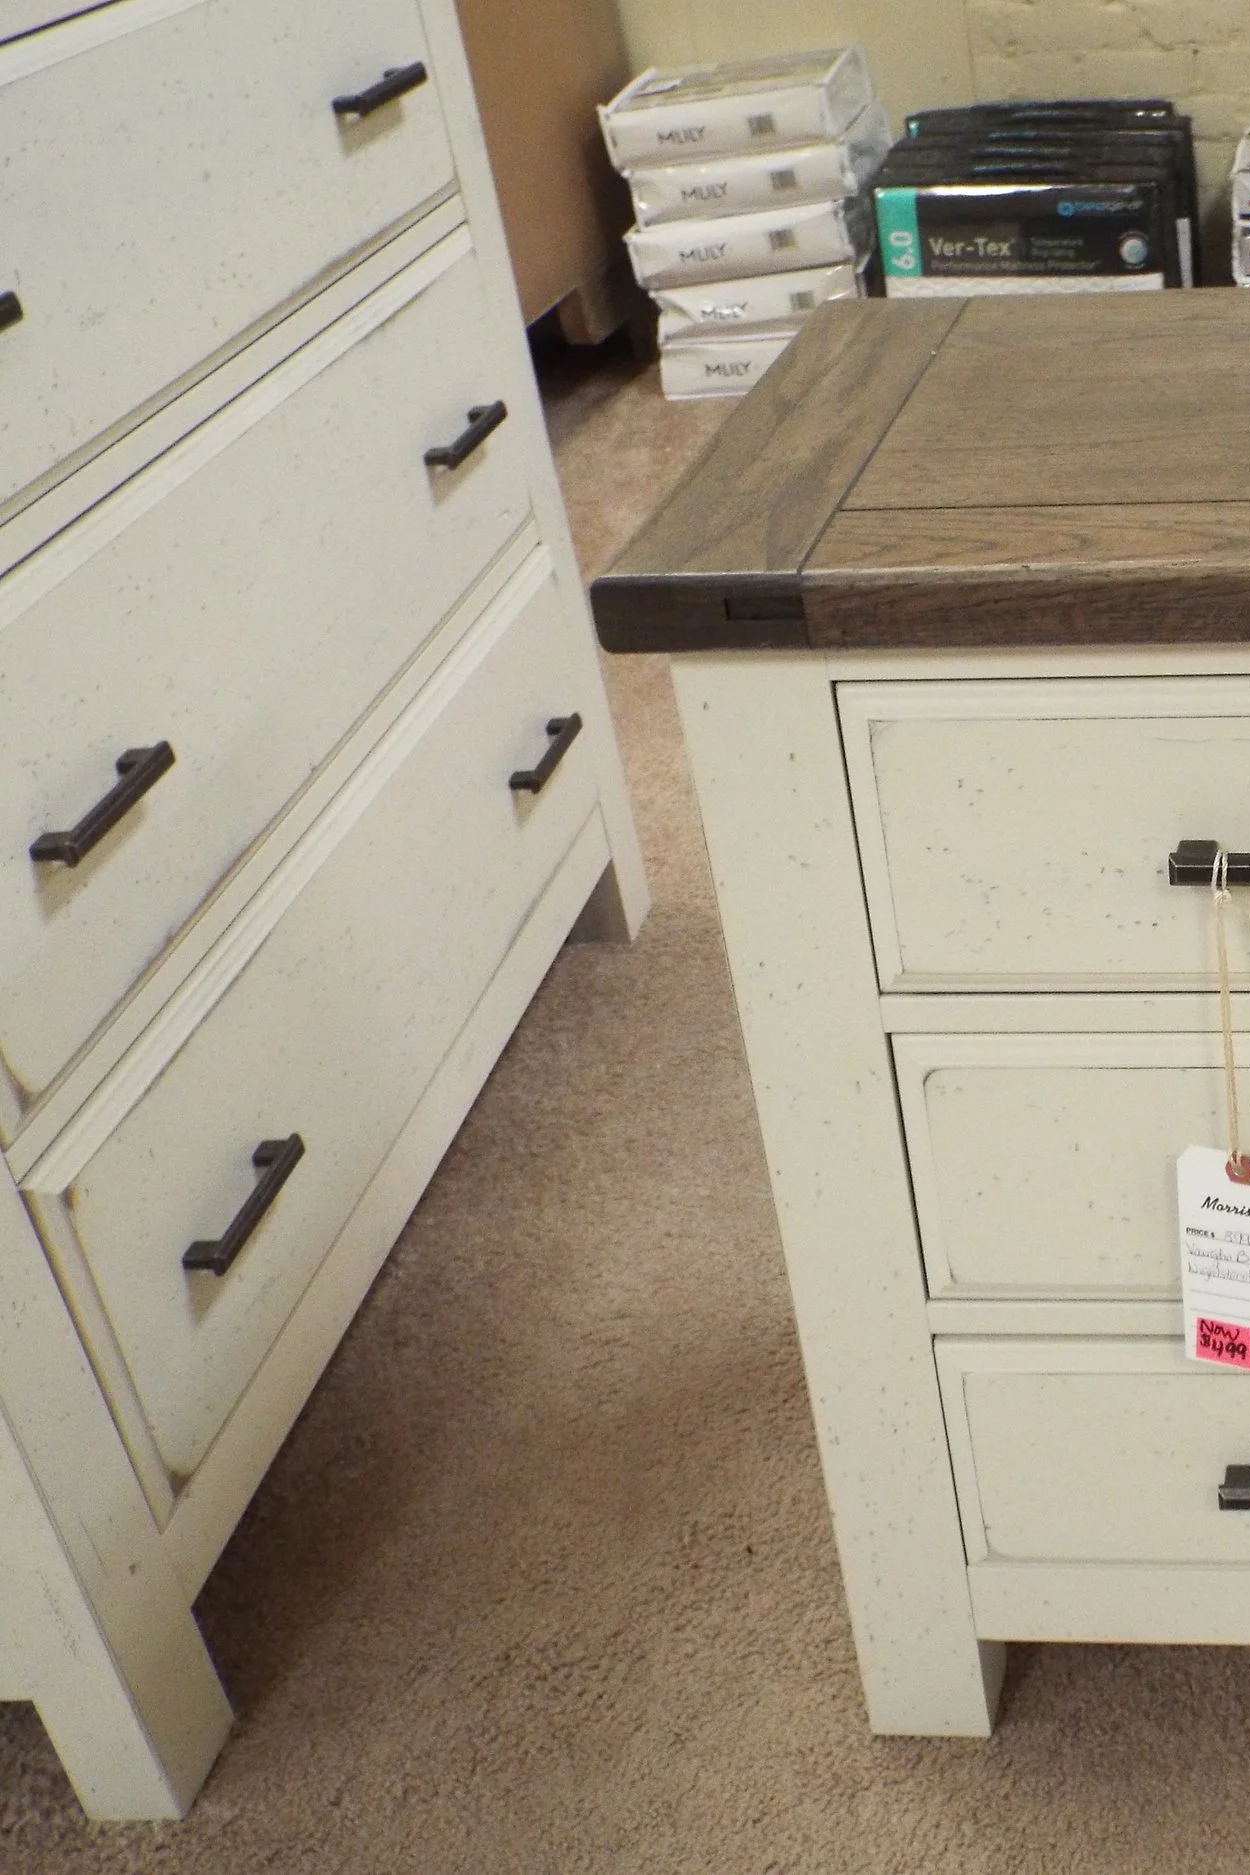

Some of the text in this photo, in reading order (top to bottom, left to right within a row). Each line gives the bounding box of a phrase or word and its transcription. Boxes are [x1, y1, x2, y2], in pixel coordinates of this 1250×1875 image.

[889, 231, 916, 270] 6.0
[928, 237, 1012, 257] Ver-Tex
[1200, 1333, 1247, 1361] $499
